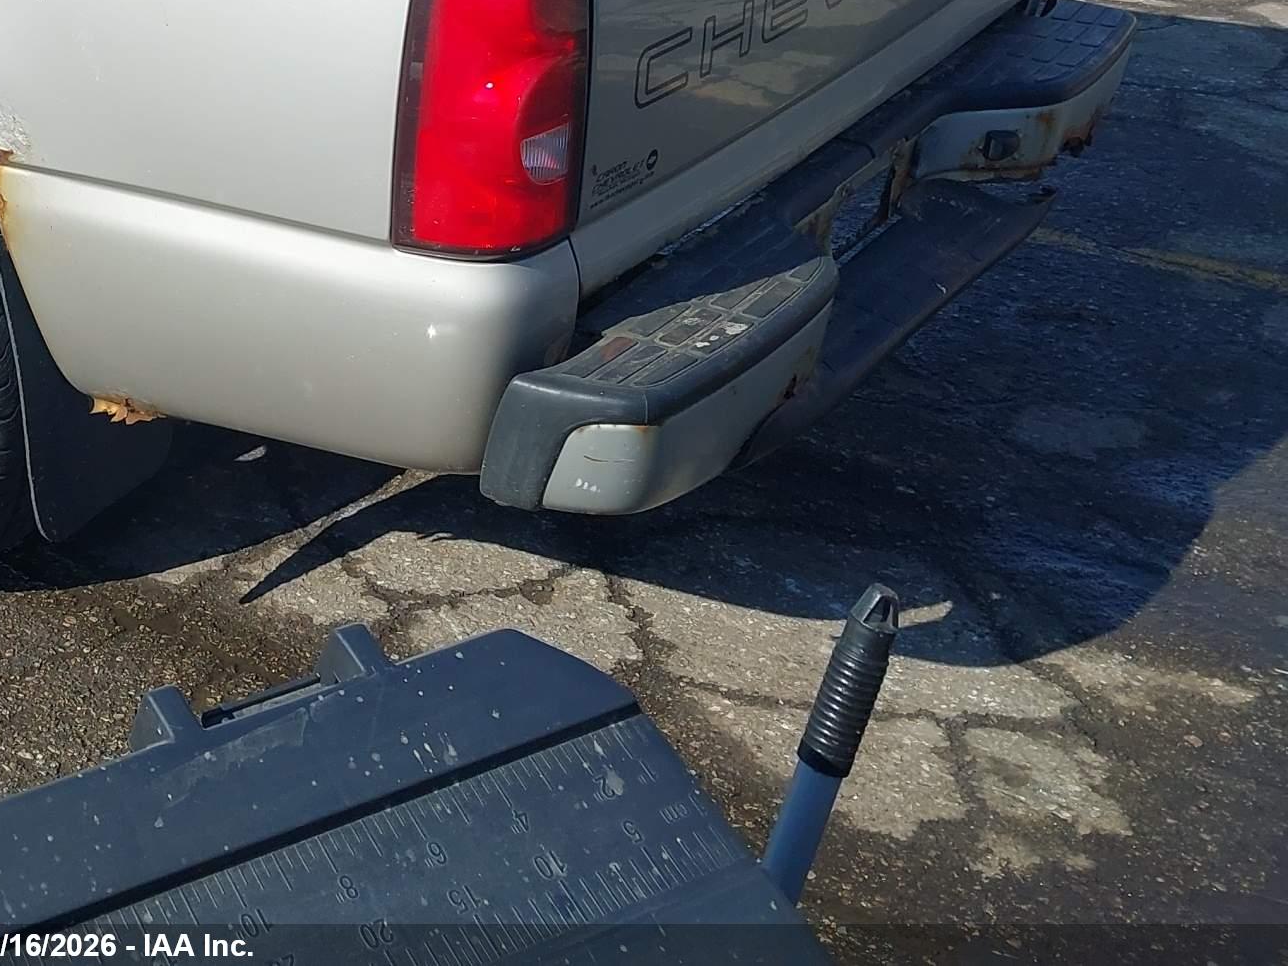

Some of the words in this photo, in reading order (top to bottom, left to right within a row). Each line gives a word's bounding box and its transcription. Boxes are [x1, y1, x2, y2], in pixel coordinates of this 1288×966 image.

[511, 810, 530, 834] 4"
[621, 819, 644, 844] 5
[424, 841, 447, 868] 6"
[532, 849, 568, 881] 10
[336, 875, 359, 904] 8"
[446, 884, 482, 914] 15
[358, 918, 394, 950] 20
